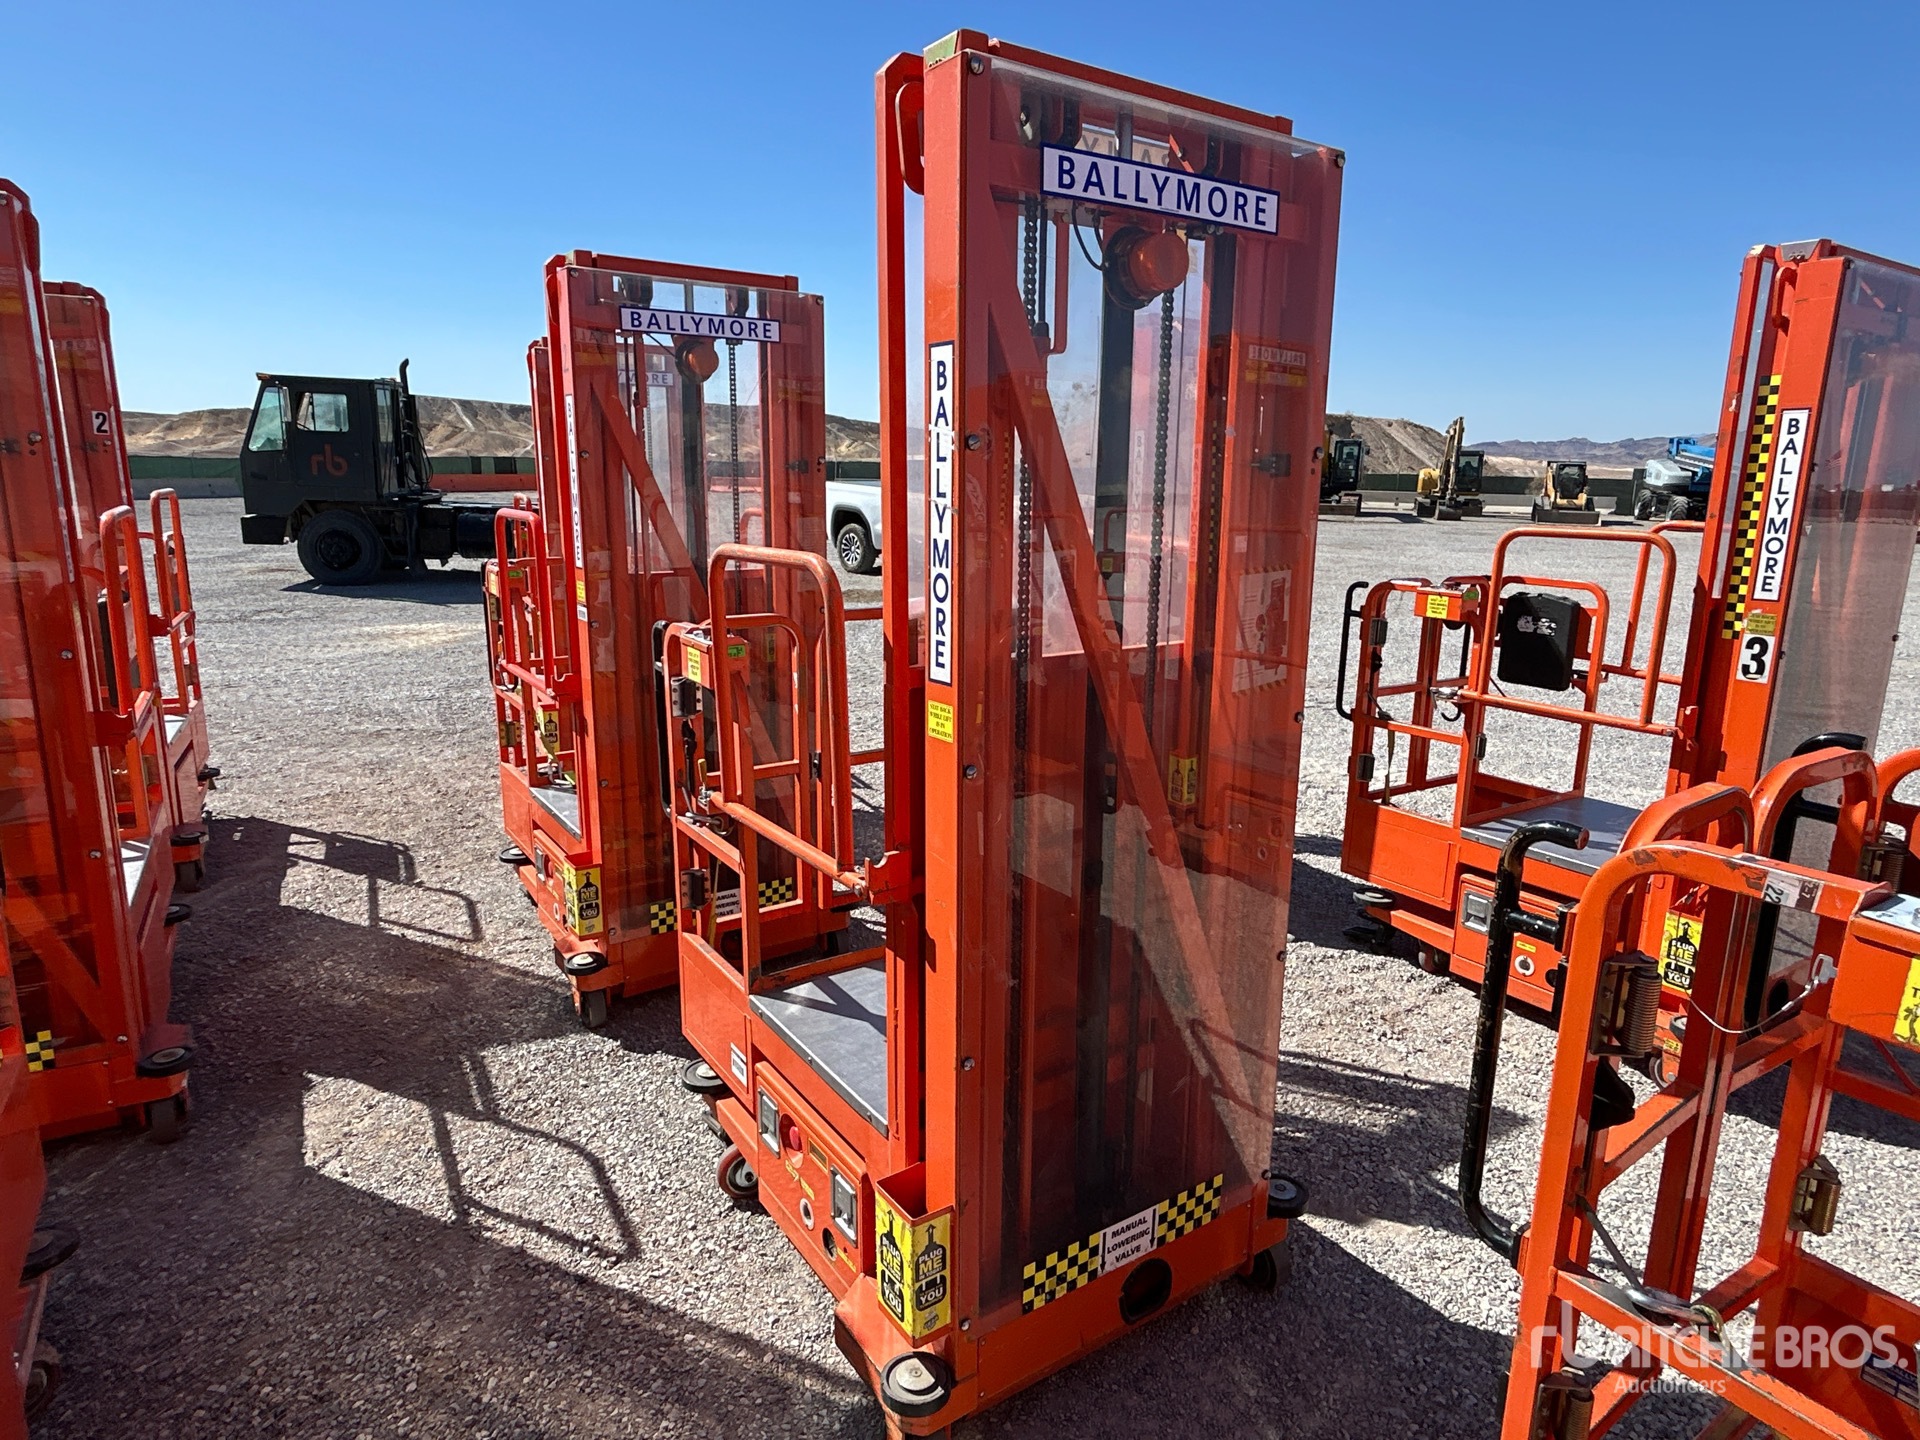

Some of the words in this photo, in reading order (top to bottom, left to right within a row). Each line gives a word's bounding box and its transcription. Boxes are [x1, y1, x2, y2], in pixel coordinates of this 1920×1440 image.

[1058, 154, 1267, 227] BALLYMORE
[630, 311, 772, 339] BALLYMORE
[95, 412, 108, 434] 2
[310, 443, 349, 476] rb
[567, 402, 581, 561] BALLYMORE
[933, 359, 950, 669] BALLYMORE
[1760, 417, 1801, 593] BALLYMORE
[1741, 636, 1769, 680] 3
[716, 893, 737, 901] ANUAL
[1765, 884, 1784, 904] 22
[582, 909, 597, 917] YOU
[1670, 946, 1694, 962] ME
[1668, 971, 1690, 985] YOU
[1111, 1216, 1148, 1239] MANUAL
[882, 1235, 901, 1260] PLUG
[1106, 1227, 1151, 1254] LOWERING
[882, 1246, 901, 1275] ME
[919, 1247, 943, 1264] PLUG
[919, 1255, 943, 1275] ME
[1115, 1244, 1142, 1263] VALVE
[884, 1284, 902, 1313] YOU
[920, 1287, 943, 1305] YOU
